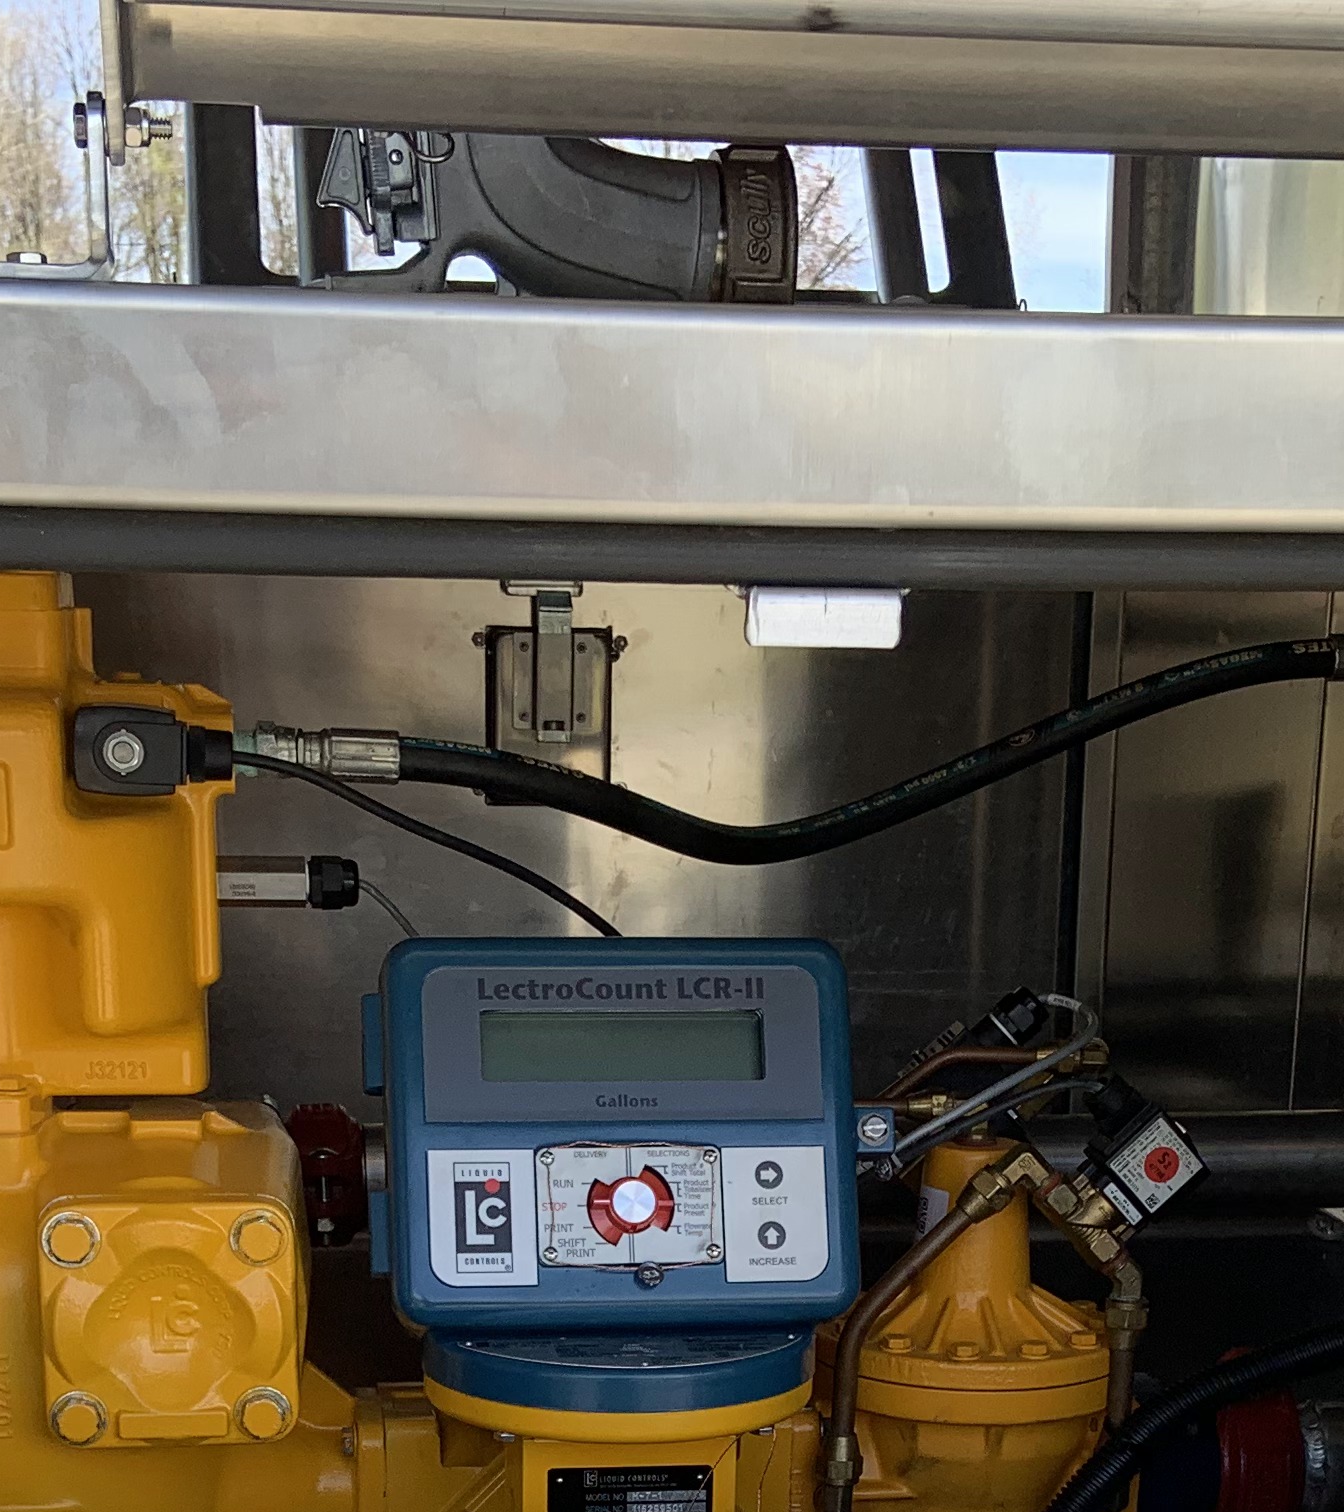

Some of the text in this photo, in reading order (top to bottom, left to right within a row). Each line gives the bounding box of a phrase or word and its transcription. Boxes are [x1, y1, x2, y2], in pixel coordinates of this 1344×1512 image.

[1292, 641, 1331, 654] TES
[477, 976, 765, 1001] LectroCount LCR-II
[84, 1060, 147, 1080] J32121
[595, 1094, 658, 1108] Gallons
[461, 1169, 503, 1177] LIQUID
[552, 1179, 574, 1188] RUN
[751, 1196, 788, 1206] SELECT
[541, 1203, 568, 1211] STOP
[543, 1223, 574, 1233] PRINT
[557, 1238, 587, 1247] SHIFT
[566, 1248, 597, 1258] PRINT
[464, 1257, 506, 1265] CONTROLS
[748, 1256, 797, 1266] INCREASE
[627, 1474, 666, 1482] CONTROLS
[585, 1493, 611, 1501] MODEL
[612, 1492, 625, 1501] NO
[612, 1505, 625, 1512] NO
